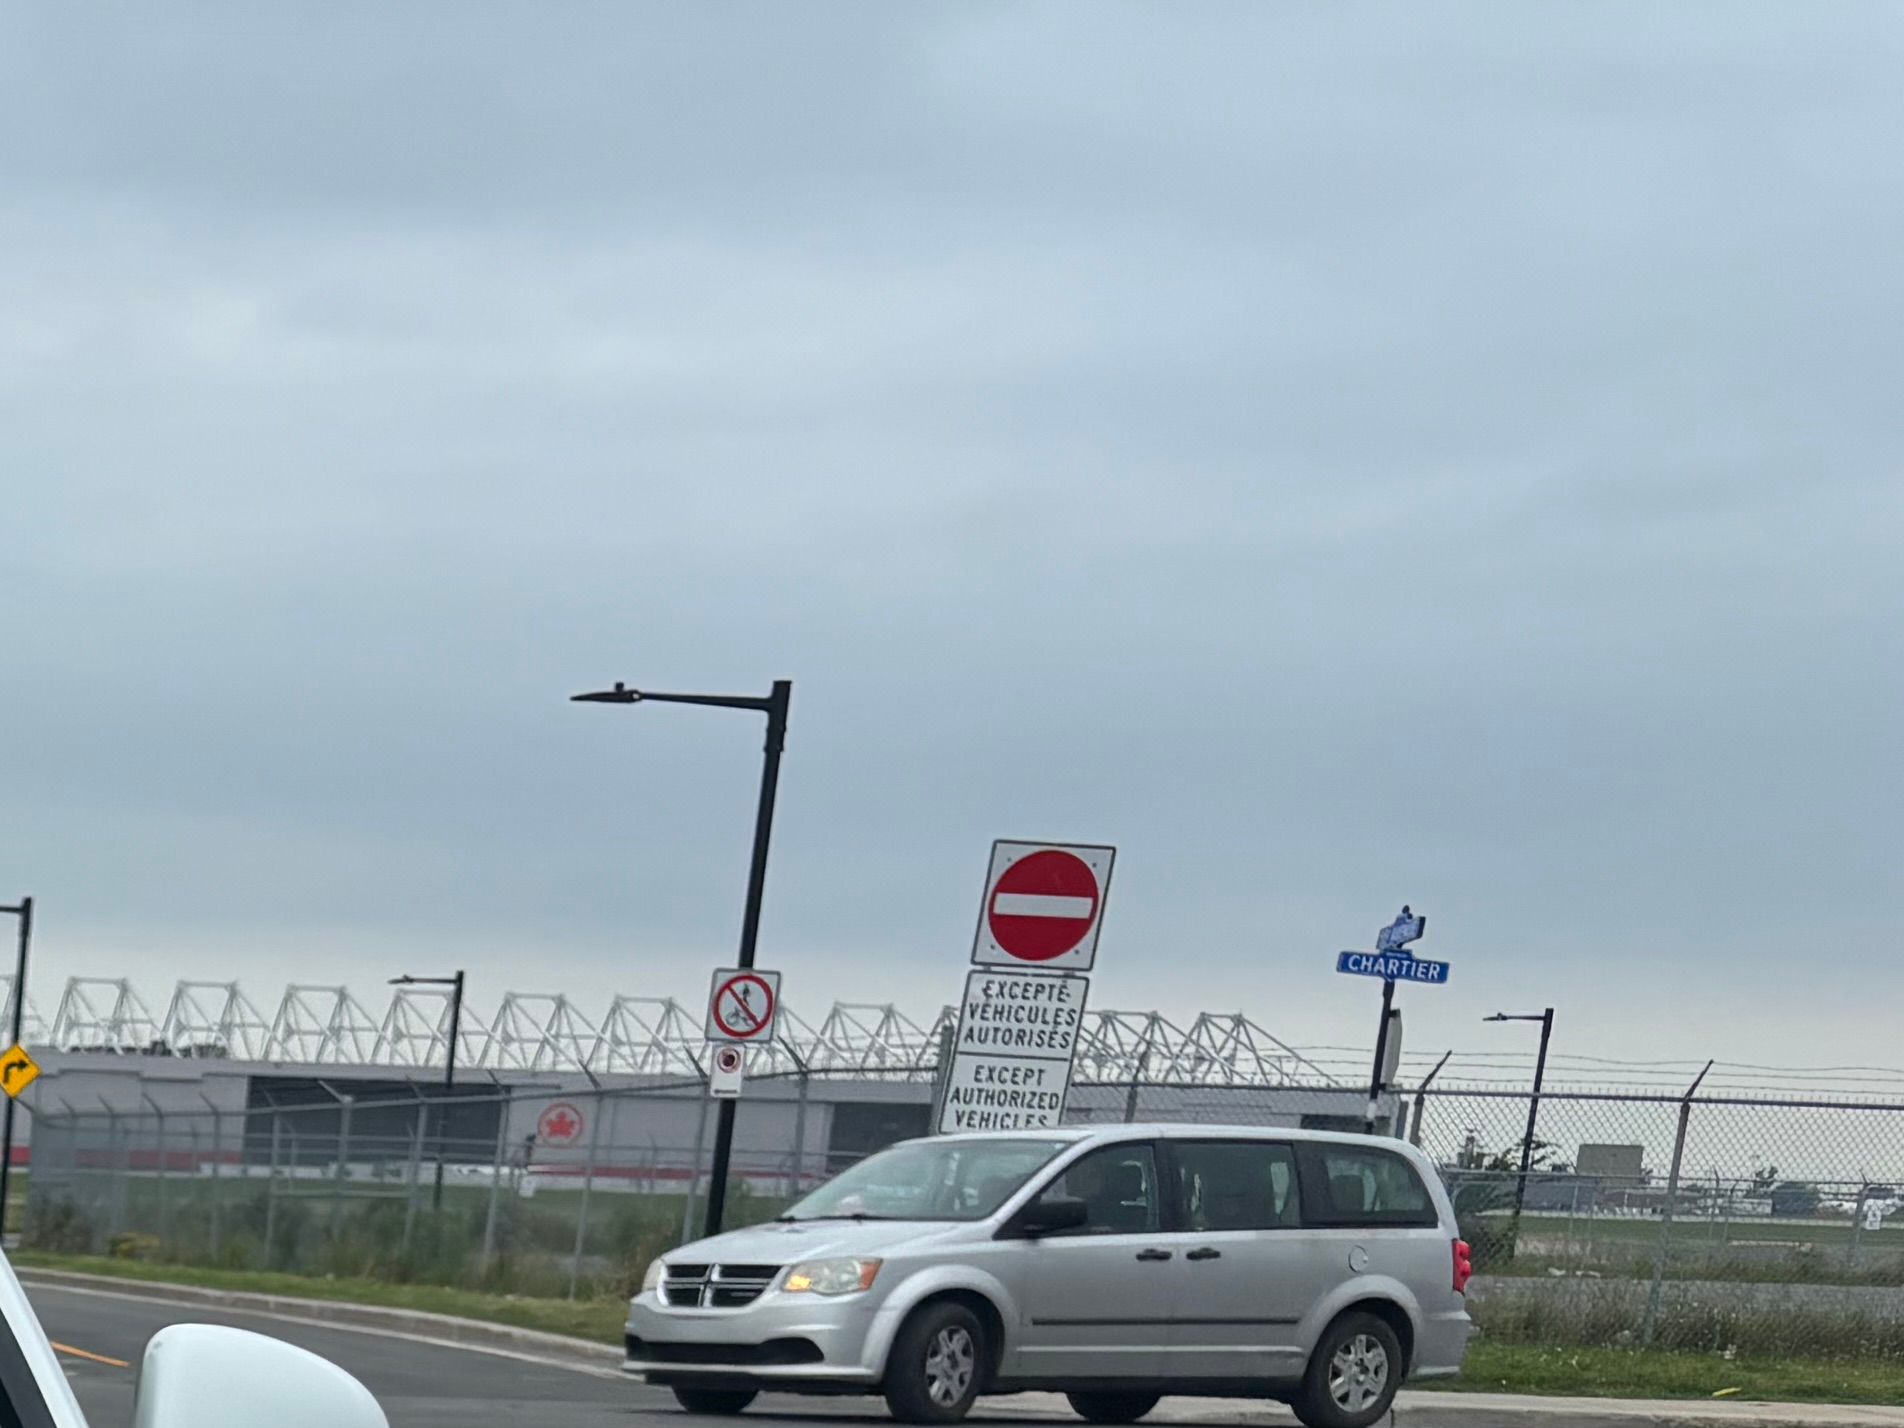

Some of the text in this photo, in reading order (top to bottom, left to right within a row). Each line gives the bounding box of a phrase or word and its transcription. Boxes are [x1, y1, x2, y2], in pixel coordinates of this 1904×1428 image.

[1348, 954, 1440, 980] CHARTIER
[981, 980, 1071, 1003] EXCEPTÉ
[964, 1026, 1071, 1049] AUTORISÉS
[973, 1065, 1047, 1086] EXCEPT
[949, 1087, 1059, 1110] AUTHORIZED
